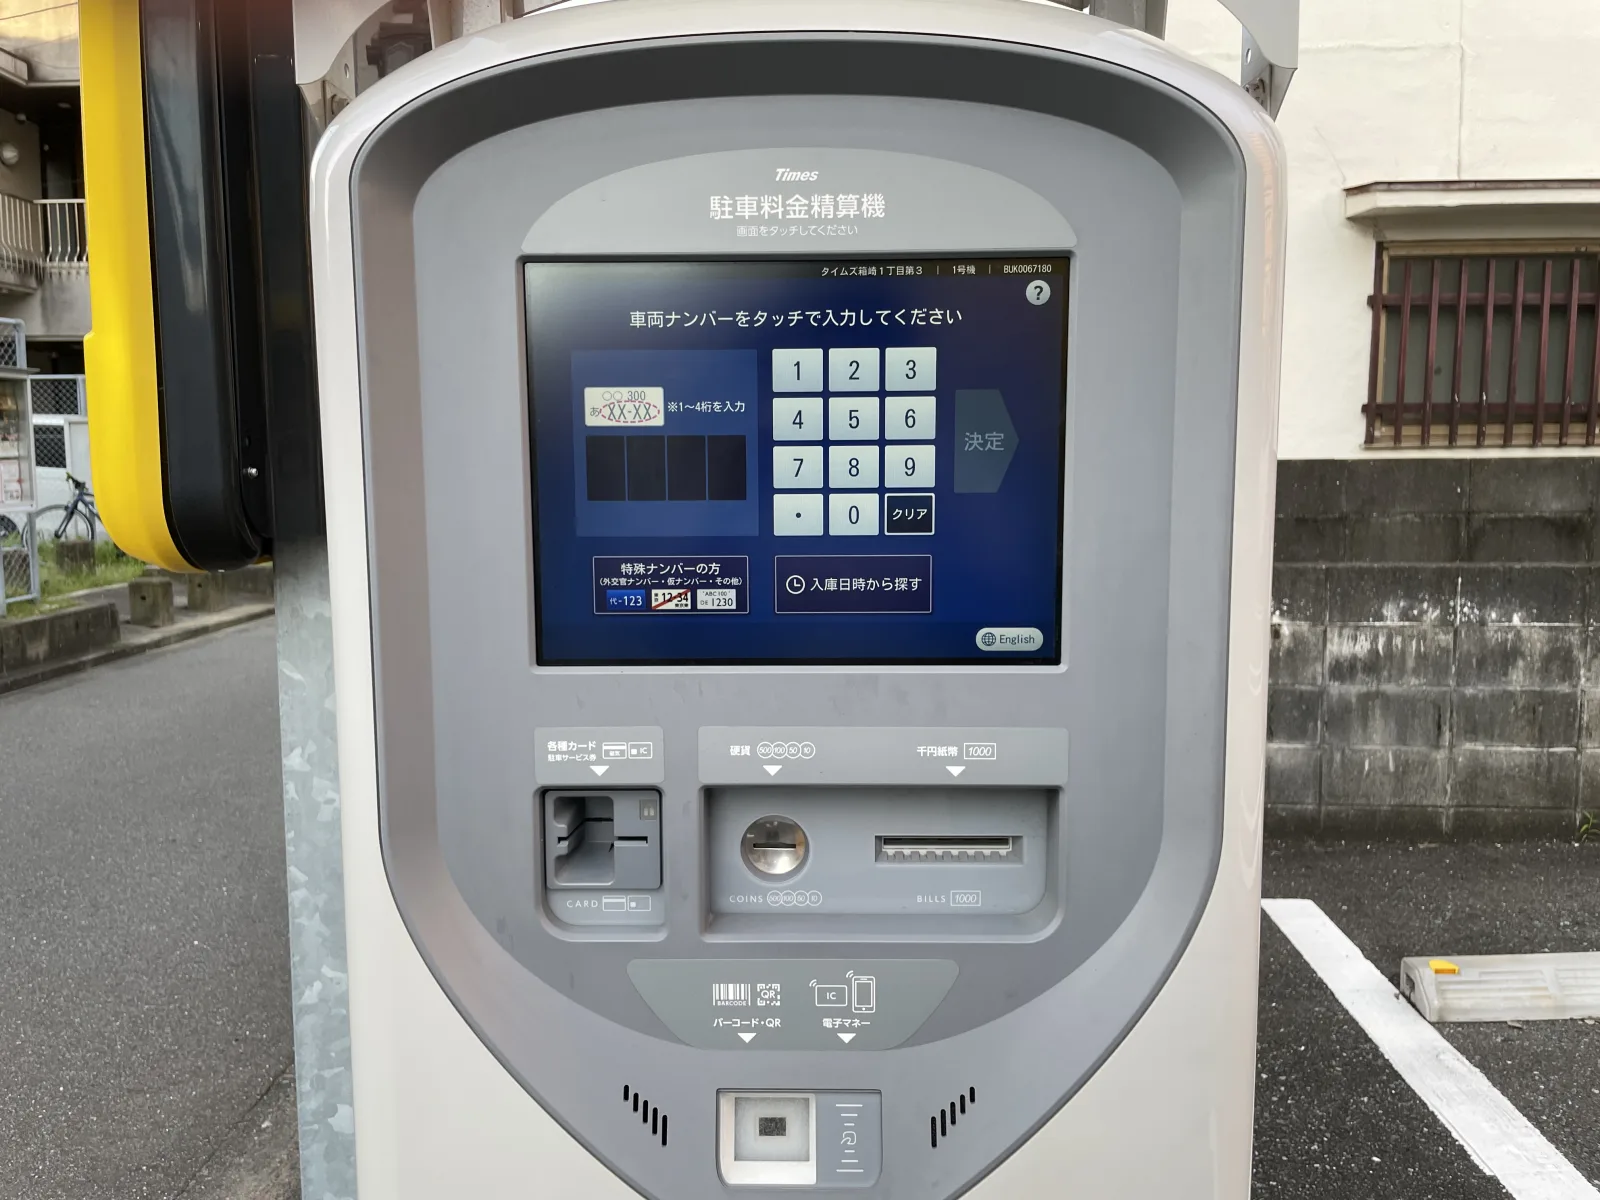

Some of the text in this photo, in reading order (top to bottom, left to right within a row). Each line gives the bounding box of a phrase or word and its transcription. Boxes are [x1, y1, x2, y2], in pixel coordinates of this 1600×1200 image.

[775, 168, 819, 182] Times
[709, 193, 886, 220] 駐車料金精算機
[736, 225, 858, 237] 画面をタッチしてください
[952, 265, 976, 275] 1号機
[1003, 264, 1052, 274] BUK0067180
[630, 309, 963, 329] 車両ナンバーをタッチで入力してください
[793, 361, 917, 381] 1 2 3
[627, 390, 646, 401] 300
[590, 404, 652, 420] あ XX-XX
[792, 409, 916, 430] 4 5 6
[964, 431, 1005, 452] 決定
[793, 457, 916, 478] 7 8 9
[848, 506, 860, 526] 0
[892, 507, 928, 521] クリア
[620, 562, 721, 575] 特殊ナンバーの方
[810, 577, 922, 592] 入庫日時から探す
[711, 598, 733, 607] 1230
[999, 632, 1035, 647] English
[547, 740, 597, 752] 各種カード
[730, 745, 751, 756] 硬貨
[917, 746, 992, 757] 千円紙幣 1000
[547, 753, 597, 762] 駐車サービス券
[566, 900, 599, 908] CARD
[729, 895, 763, 903] COINS
[916, 893, 977, 903] BILLS 1000
[760, 990, 776, 999] QR
[826, 992, 837, 1000] IC
[713, 1018, 781, 1028] バーコード・QR
[822, 1018, 871, 1028] 電子マネー
